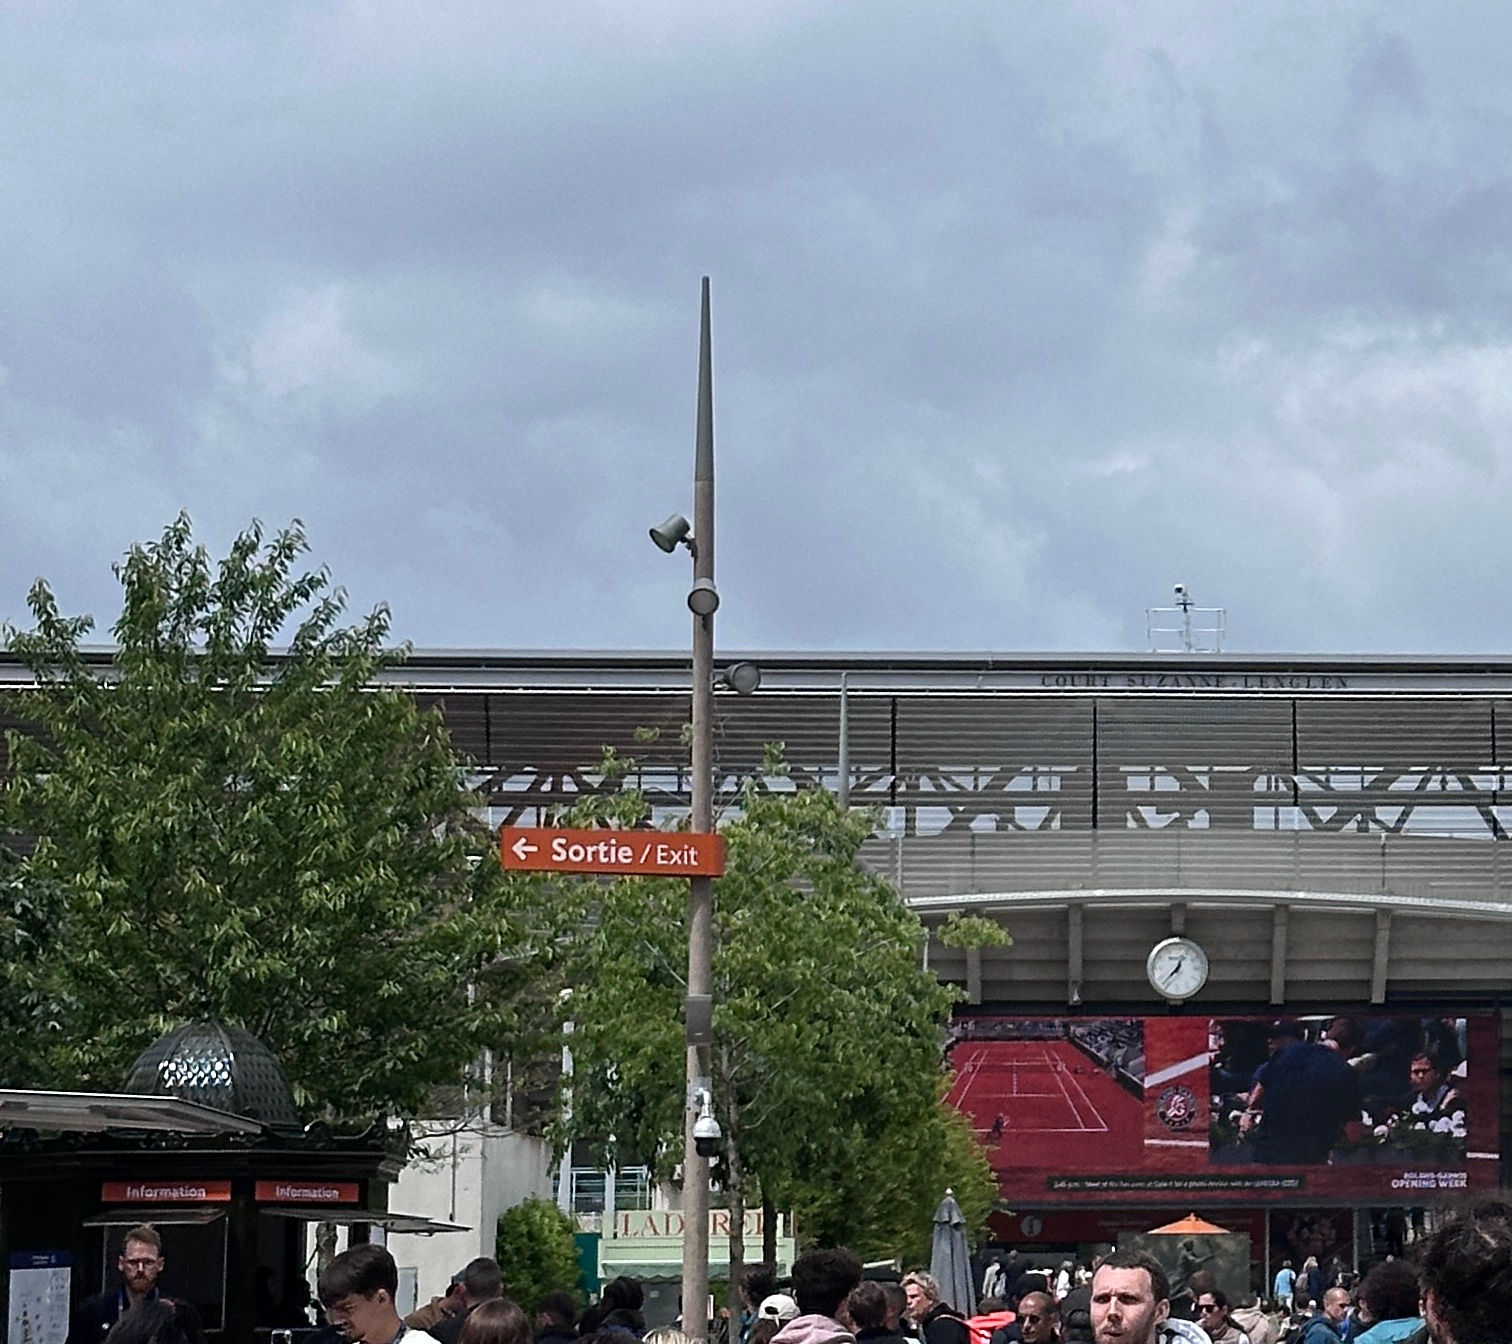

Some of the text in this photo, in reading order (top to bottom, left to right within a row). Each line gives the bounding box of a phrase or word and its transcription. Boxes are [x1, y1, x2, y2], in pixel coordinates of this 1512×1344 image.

[1041, 673, 1111, 688] COURT
[551, 838, 633, 864] Sortie
[656, 844, 699, 866] Exit
[1391, 1179, 1468, 1189] OPENING WEEK
[127, 1185, 206, 1198] Information
[276, 1185, 340, 1198] Information
